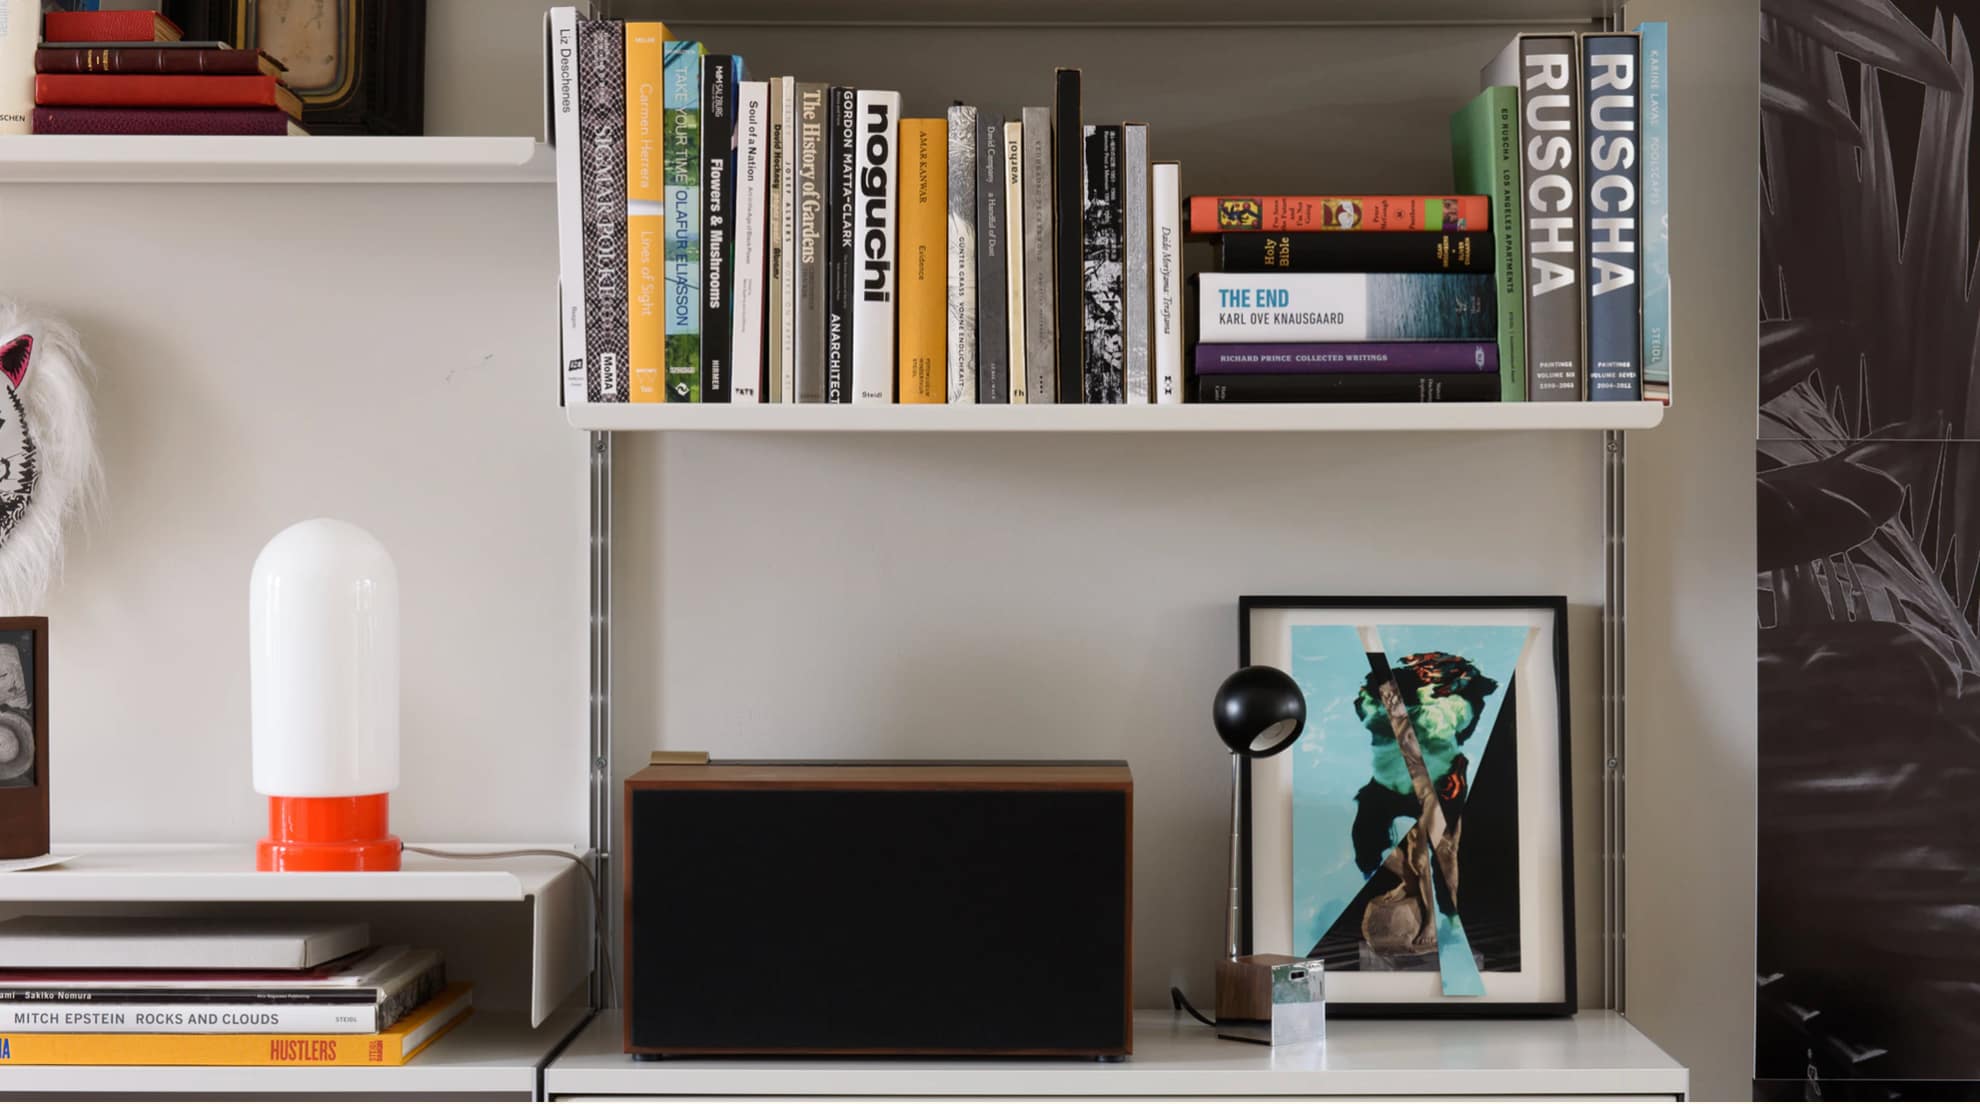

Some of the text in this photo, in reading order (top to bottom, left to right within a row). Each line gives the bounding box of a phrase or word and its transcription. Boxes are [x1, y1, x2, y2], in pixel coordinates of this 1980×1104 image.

[560, 28, 572, 114] Liz Deschenes
[675, 66, 689, 103] TAKE
[715, 84, 724, 118] SALZBURG
[748, 100, 758, 125] Soul
[843, 90, 853, 148] GORDON
[639, 83, 654, 189] Carmen Herrera
[675, 107, 689, 146] YOUR
[748, 126, 758, 136] of
[774, 123, 782, 150] David
[987, 126, 996, 147] David
[1650, 49, 1661, 205] KARINE LAVAL POOLSCAPES
[675, 149, 689, 183] TIME
[746, 146, 758, 182] Nation
[772, 151, 782, 190] Hockney
[799, 89, 821, 264] The History of Gardens
[919, 130, 928, 204] AMAR KANWAR
[1008, 140, 1019, 185] warhol
[1525, 53, 1575, 297] RUSCHA
[1590, 53, 1635, 297] RUSCHA
[594, 126, 616, 299] SIGMAR POLKE
[842, 152, 853, 248] MATTA-CLARK
[861, 104, 891, 303] noguchi
[1501, 107, 1514, 293] ED RUSCHA LOS ANGELES APARTMENTS
[709, 158, 724, 309] Flowers & Mushrooms
[988, 229, 997, 238] of
[1264, 238, 1277, 265] Holy
[1279, 236, 1290, 267] Bible
[638, 231, 656, 317] Lines of Sight
[675, 190, 689, 327] OLAFUR ELIASSON
[918, 245, 928, 281] Evidence
[1160, 252, 1172, 293] Moriyama
[958, 270, 966, 297] GRASS
[1217, 288, 1289, 308] THE END
[1218, 312, 1344, 325] KARL OVE KNAUSGAARD
[830, 313, 841, 404] ANARCHITECT
[958, 301, 967, 387] VONNE ENDLICHKAIT
[1219, 354, 1258, 363] RICHARD
[1260, 354, 1291, 362] PRINCE
[1295, 354, 1344, 362] COLLECTED
[1651, 327, 1661, 363] STEIDL
[604, 355, 614, 391] MoMA
[711, 360, 720, 390] HIRMER
[24, 991, 54, 1000] Sakiko
[57, 991, 93, 1000] Nomura
[14, 1012, 280, 1025] MITCH EPSTEIN ROCKS AND CLOUDS
[0, 1038, 337, 1062] A HUSTLERS
